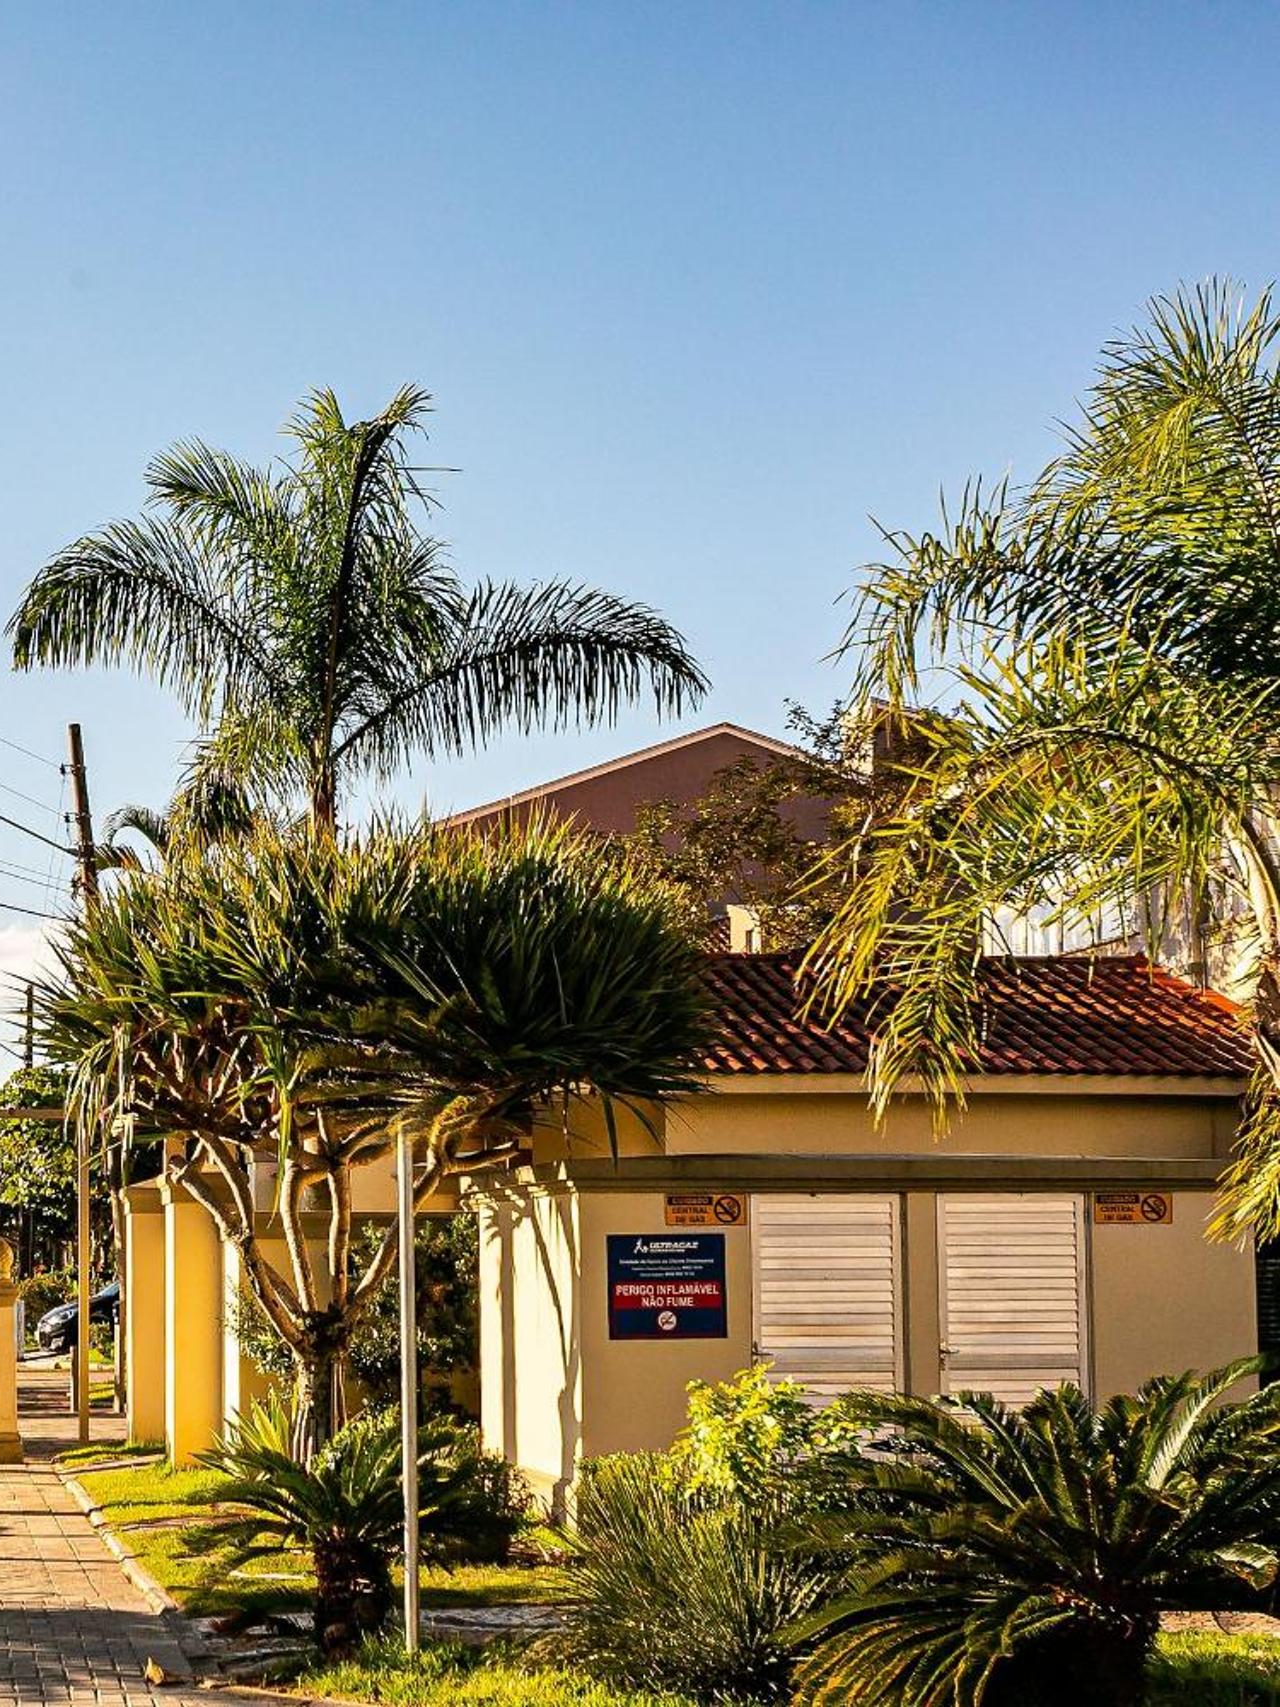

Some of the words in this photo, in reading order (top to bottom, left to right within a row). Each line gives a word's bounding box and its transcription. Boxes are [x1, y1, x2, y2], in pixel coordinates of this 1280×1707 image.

[672, 1206, 707, 1214] CENTRAL
[1100, 1205, 1136, 1213] CENTRAL
[649, 1241, 699, 1249] ULTRAGAZ
[615, 1285, 654, 1296] PERIGO
[657, 1282, 719, 1295] INFLAMÁVEL
[641, 1295, 665, 1307] NÃO
[666, 1297, 694, 1306] FUME
